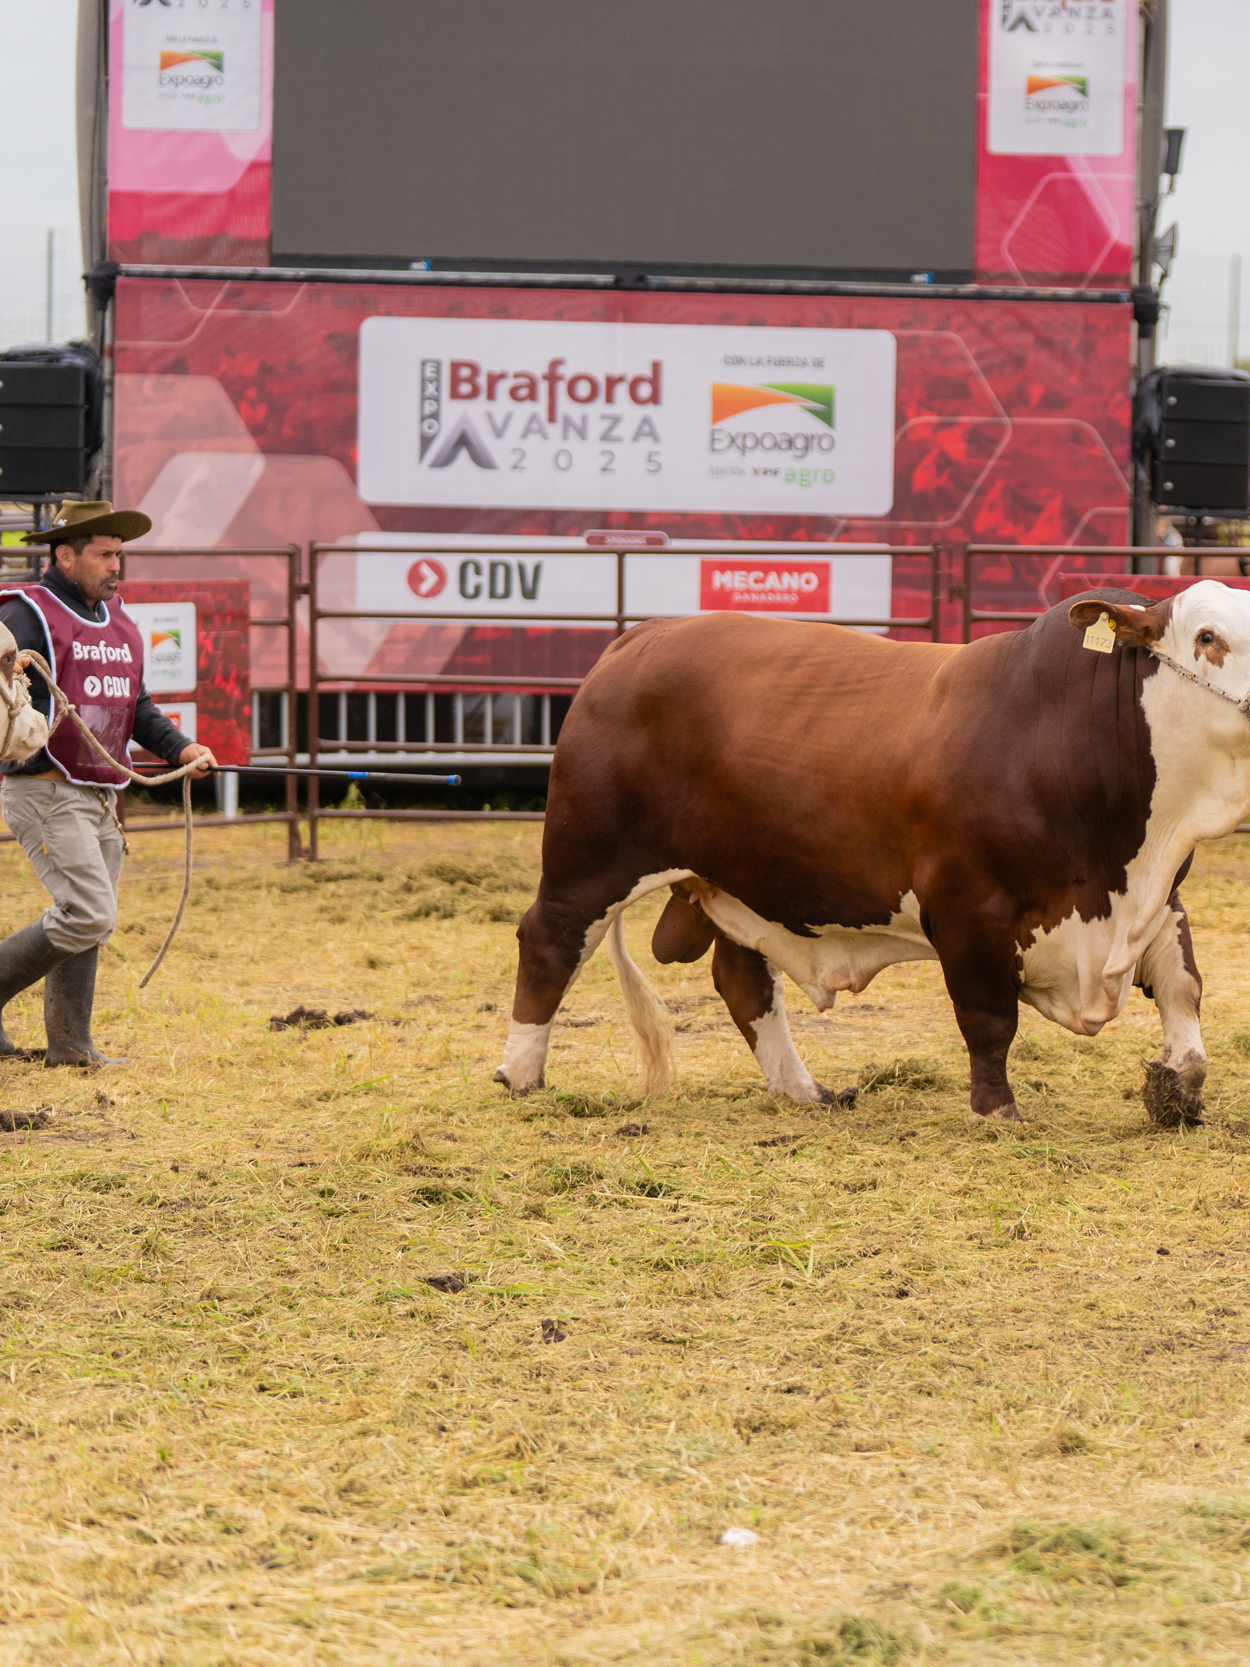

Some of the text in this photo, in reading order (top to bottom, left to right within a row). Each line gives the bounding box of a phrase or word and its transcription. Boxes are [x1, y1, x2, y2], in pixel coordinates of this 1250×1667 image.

[158, 73, 225, 89] Expoagro
[1025, 99, 1091, 114] Expoagro
[723, 355, 747, 366] CON
[749, 355, 765, 367] LA
[812, 356, 827, 368] DE
[421, 360, 440, 439] EXPO
[449, 356, 663, 424] Braford
[710, 428, 837, 460] Expoagro
[509, 446, 663, 475] 2025
[784, 467, 836, 488] agro
[458, 557, 544, 601] CDV
[712, 569, 819, 593] MECANO
[732, 592, 799, 605] GANADERO
[72, 640, 133, 665] Braford
[1085, 634, 1113, 649] 11173
[103, 675, 131, 698] CDV
